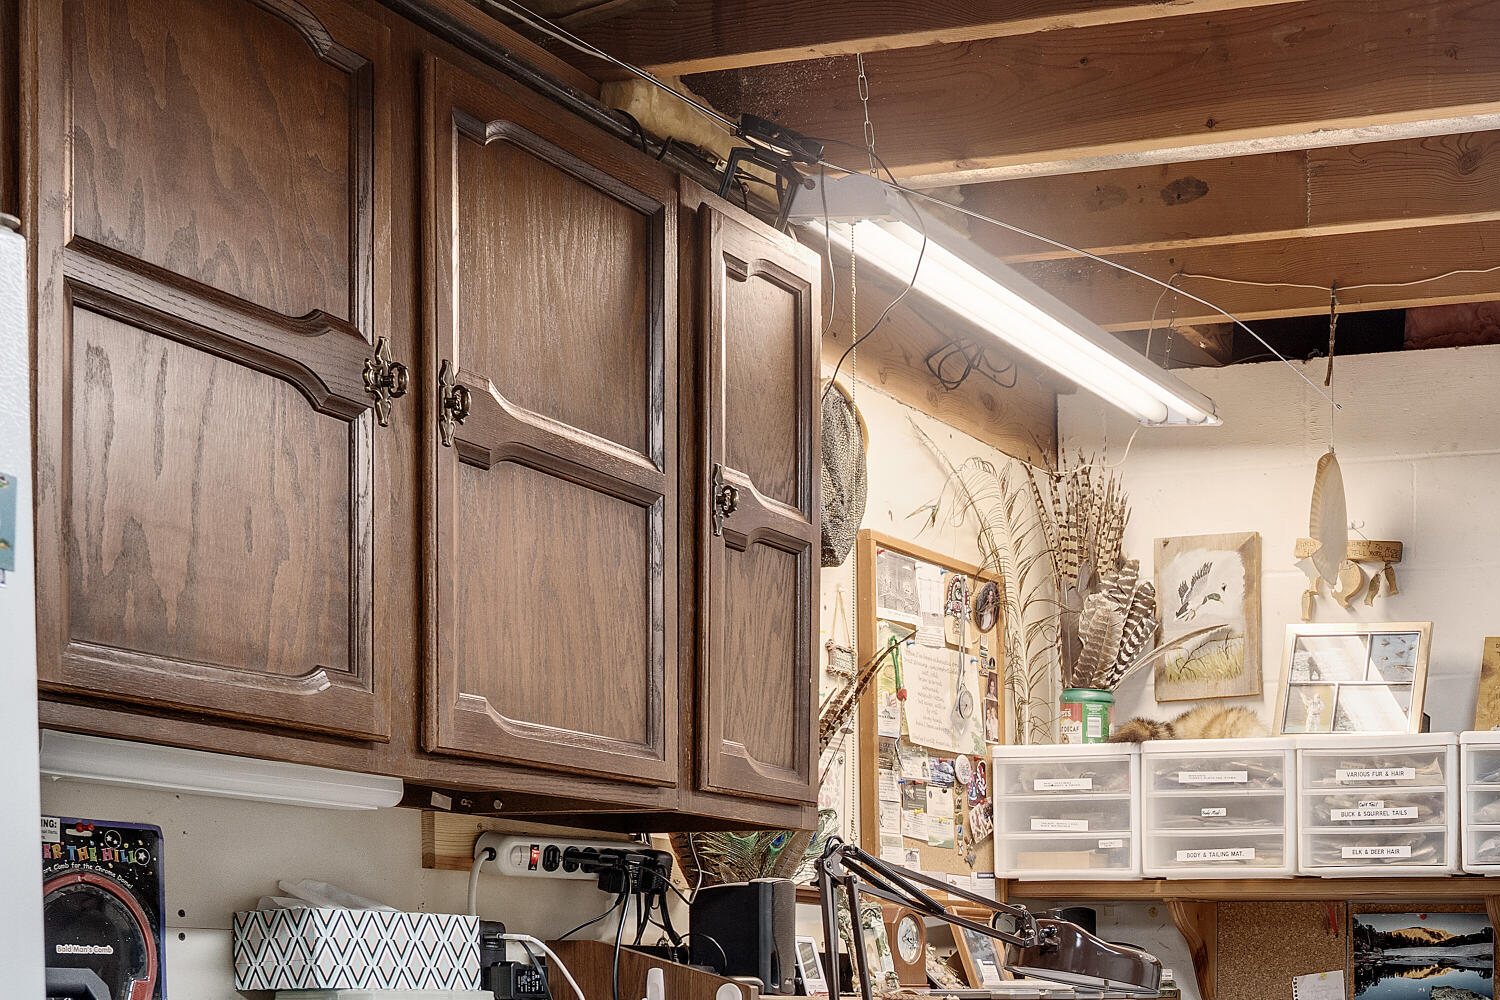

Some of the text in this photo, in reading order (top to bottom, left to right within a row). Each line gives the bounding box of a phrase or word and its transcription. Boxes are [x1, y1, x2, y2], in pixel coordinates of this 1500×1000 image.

[1363, 810, 1390, 818] SQUIRREL
[41, 819, 57, 829] ING:
[43, 844, 138, 865] ER THE HILL
[1230, 850, 1245, 858] MAT.
[53, 863, 70, 871] Comb
[71, 861, 81, 870] for
[95, 865, 116, 878] Chrome
[116, 874, 134, 889] Dome!
[56, 945, 113, 954] Bald Man's Comb
